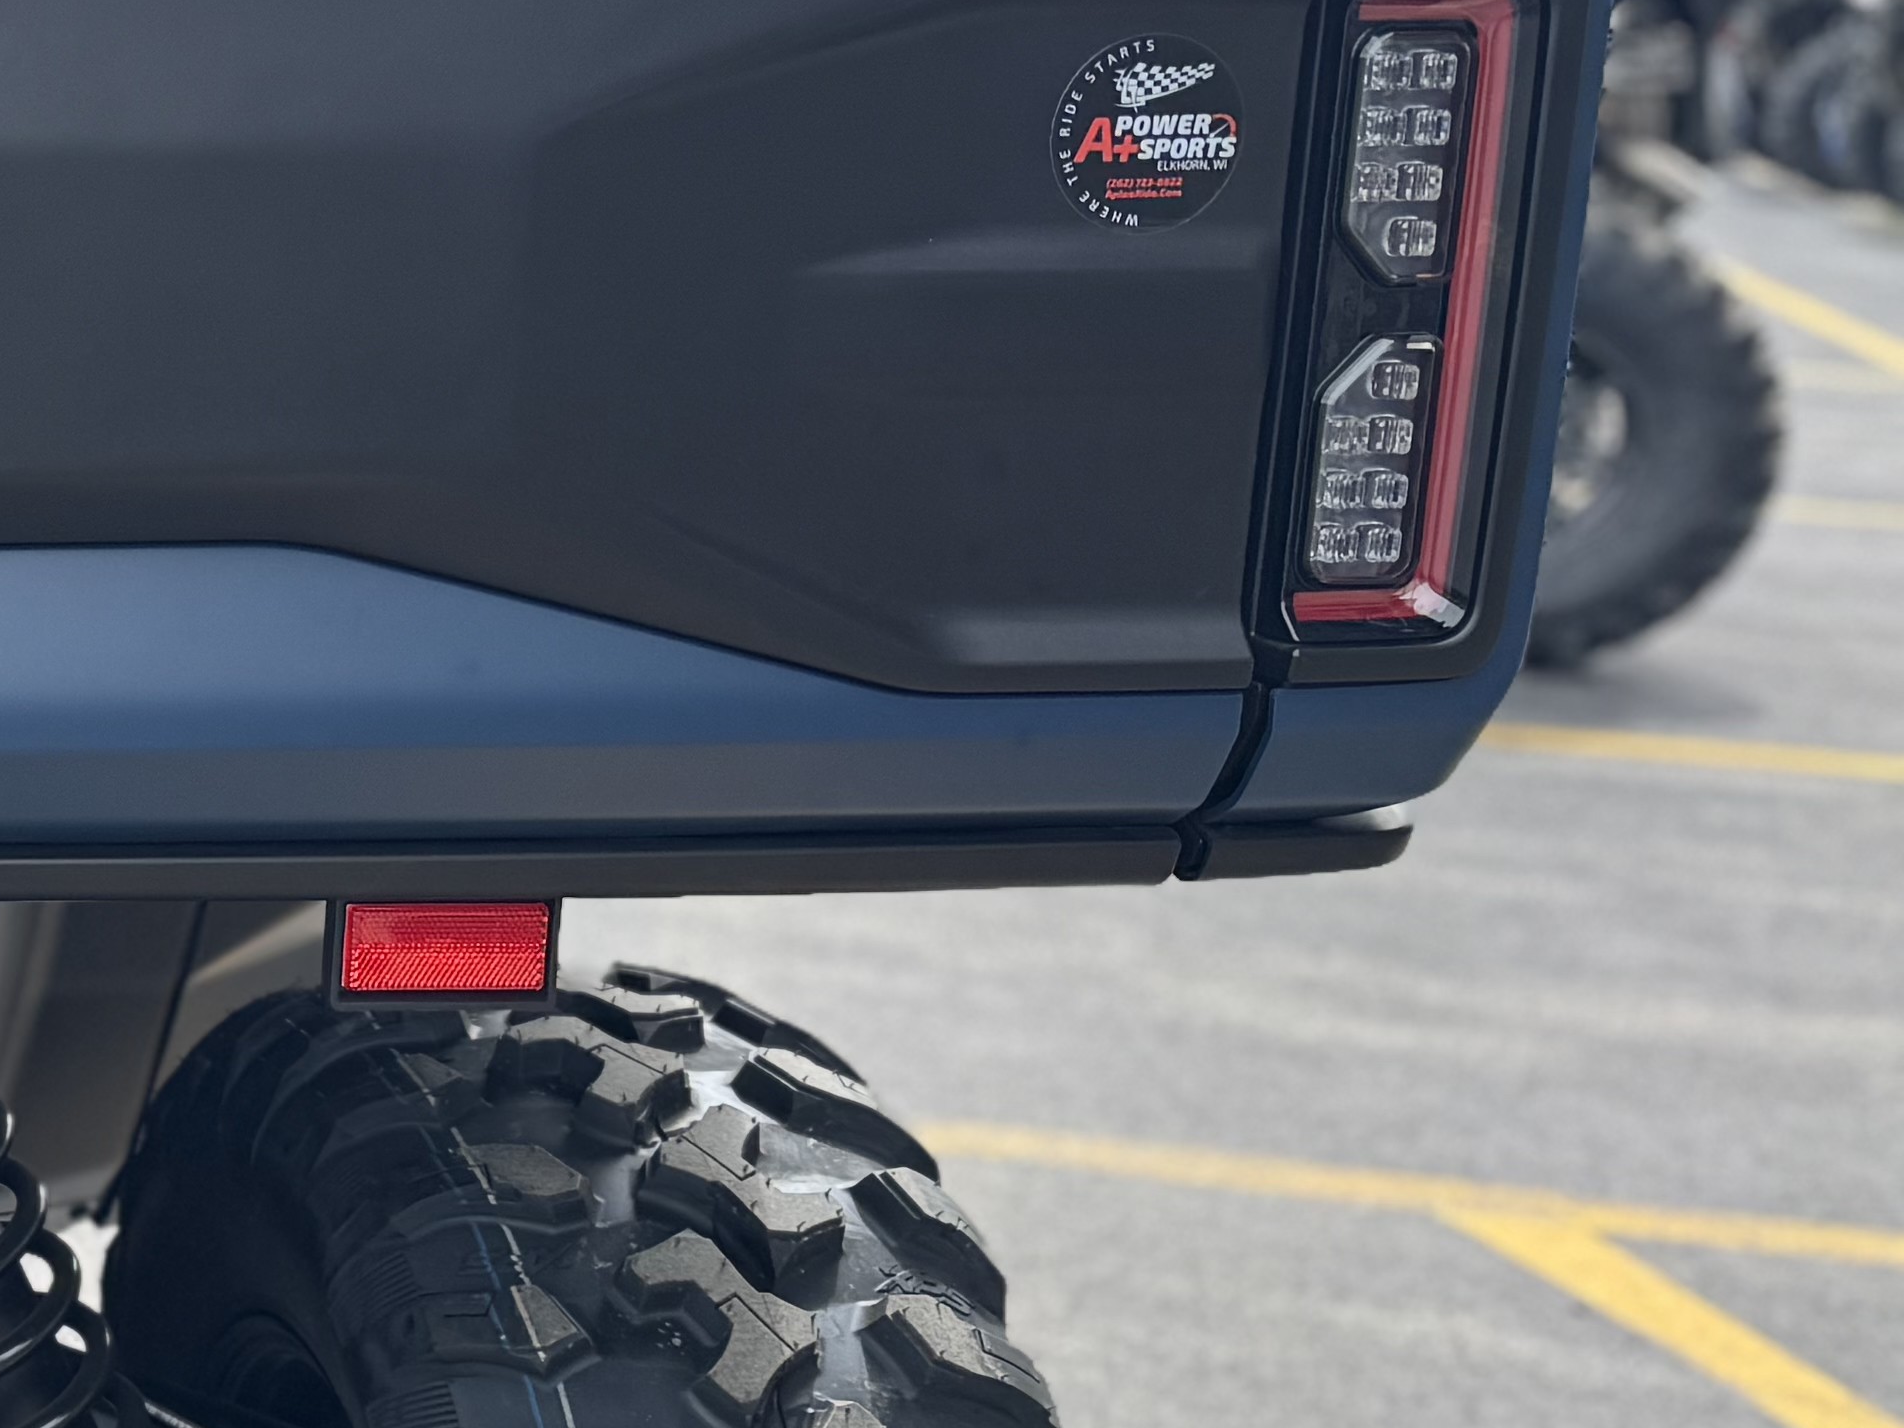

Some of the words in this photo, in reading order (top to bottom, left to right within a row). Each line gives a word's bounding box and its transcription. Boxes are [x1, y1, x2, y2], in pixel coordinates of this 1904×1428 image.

[1084, 39, 1156, 84] STARTS
[1059, 92, 1083, 137] RIDE
[1073, 116, 1141, 163] A+
[1114, 113, 1213, 137] POWER
[1137, 136, 1237, 160] SPORTS
[1059, 149, 1079, 187] THE
[1213, 159, 1228, 171] WI
[1078, 190, 1139, 227] WHERE
